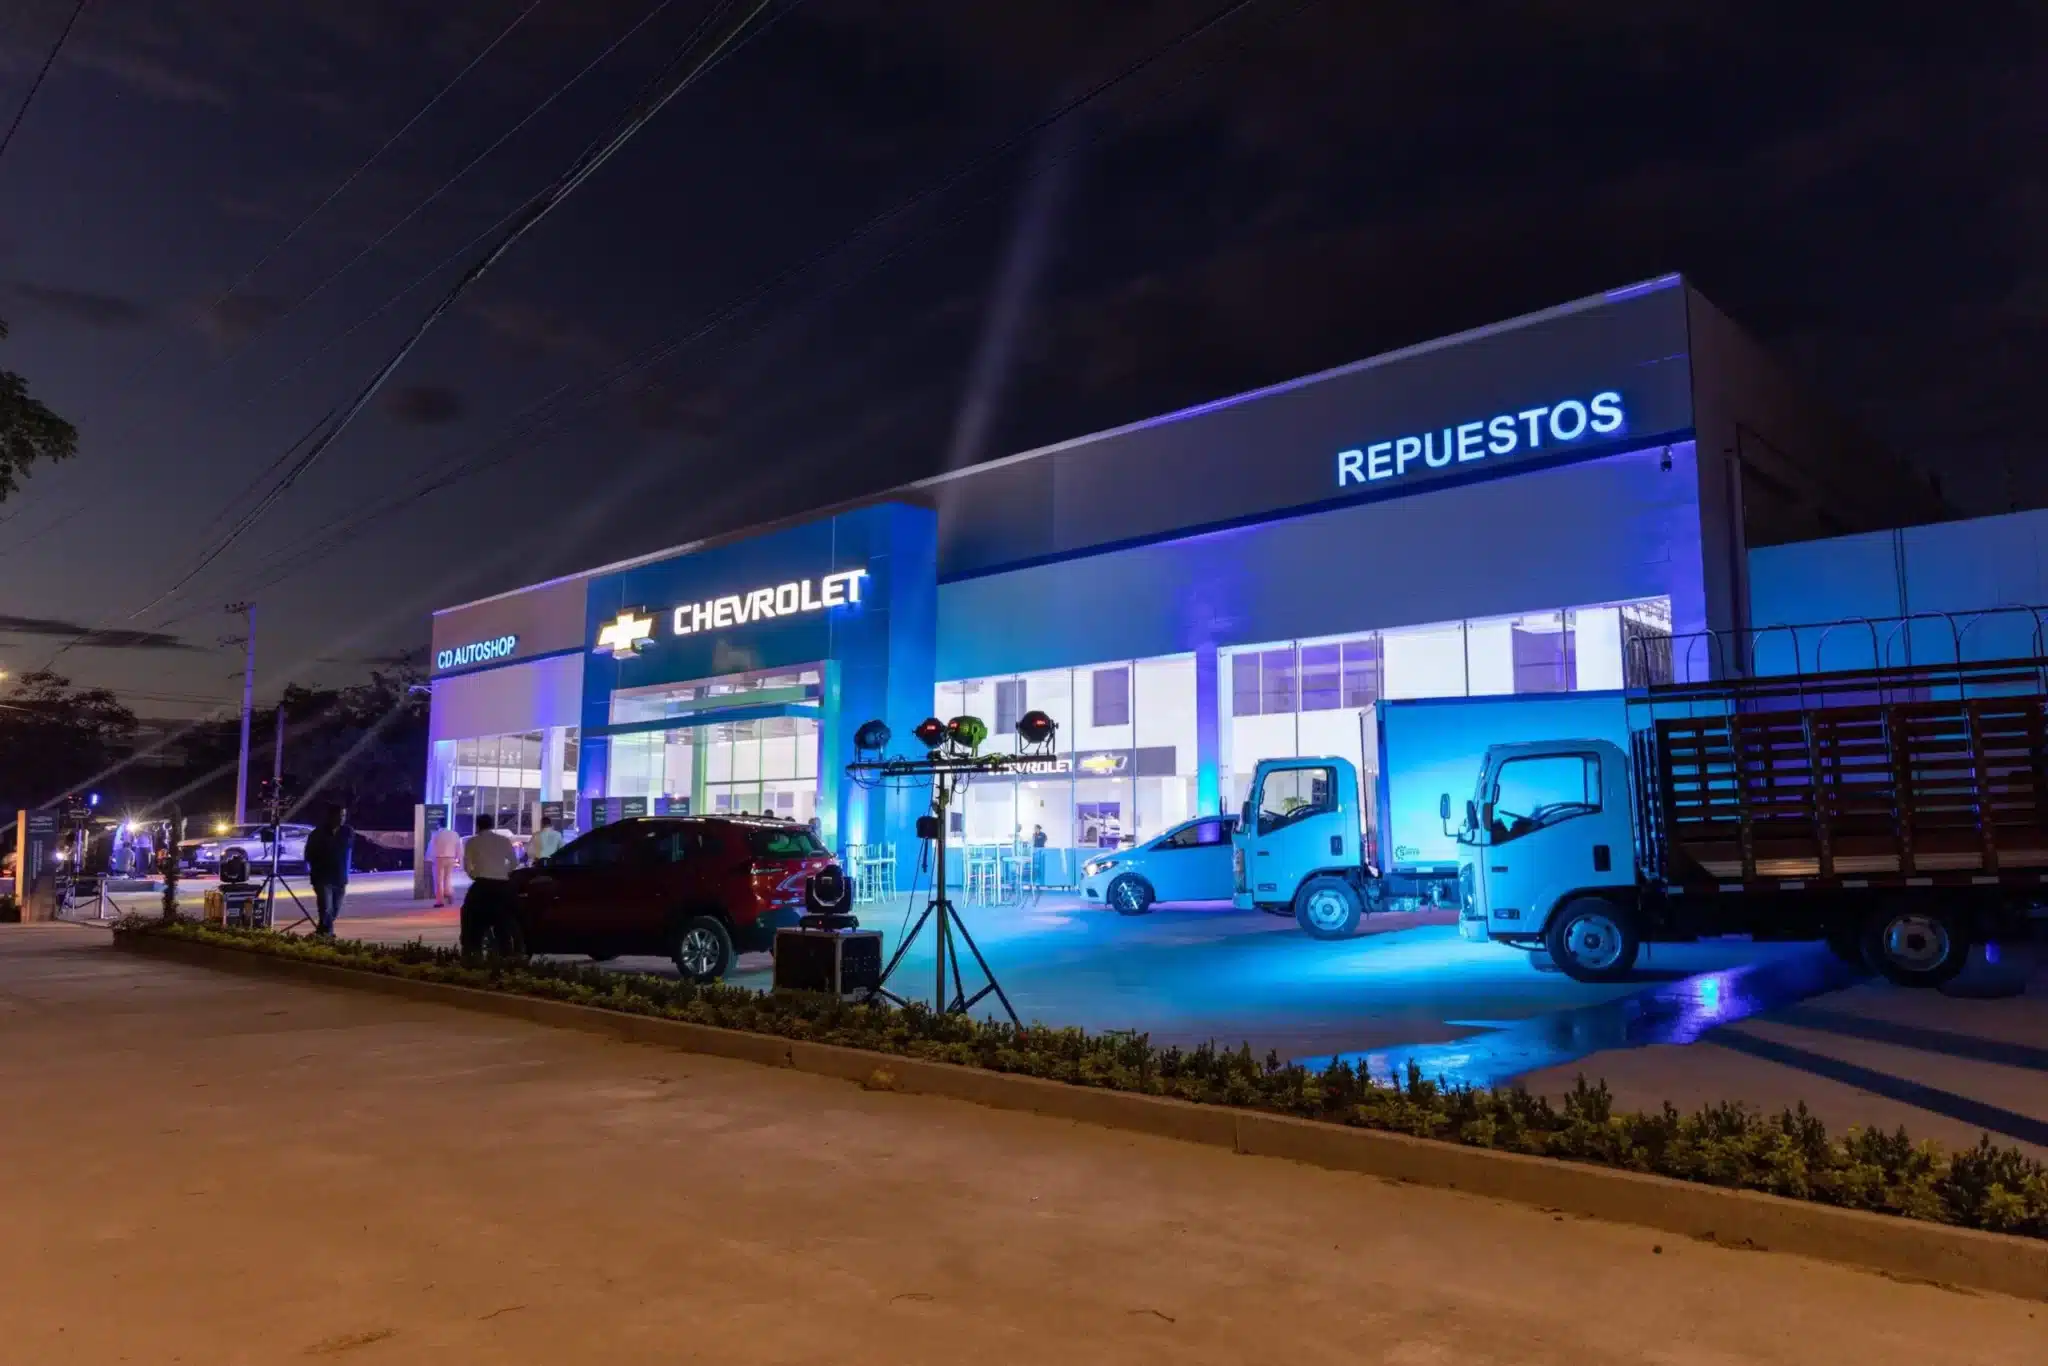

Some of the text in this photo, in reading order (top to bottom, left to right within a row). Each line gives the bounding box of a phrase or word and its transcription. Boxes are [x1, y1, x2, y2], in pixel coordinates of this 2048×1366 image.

[1337, 391, 1624, 487] REPUESTOS
[673, 568, 867, 636] CHEVROLET
[437, 635, 516, 669] CD AUTOSHOP
[988, 759, 1073, 776] EVROLET
